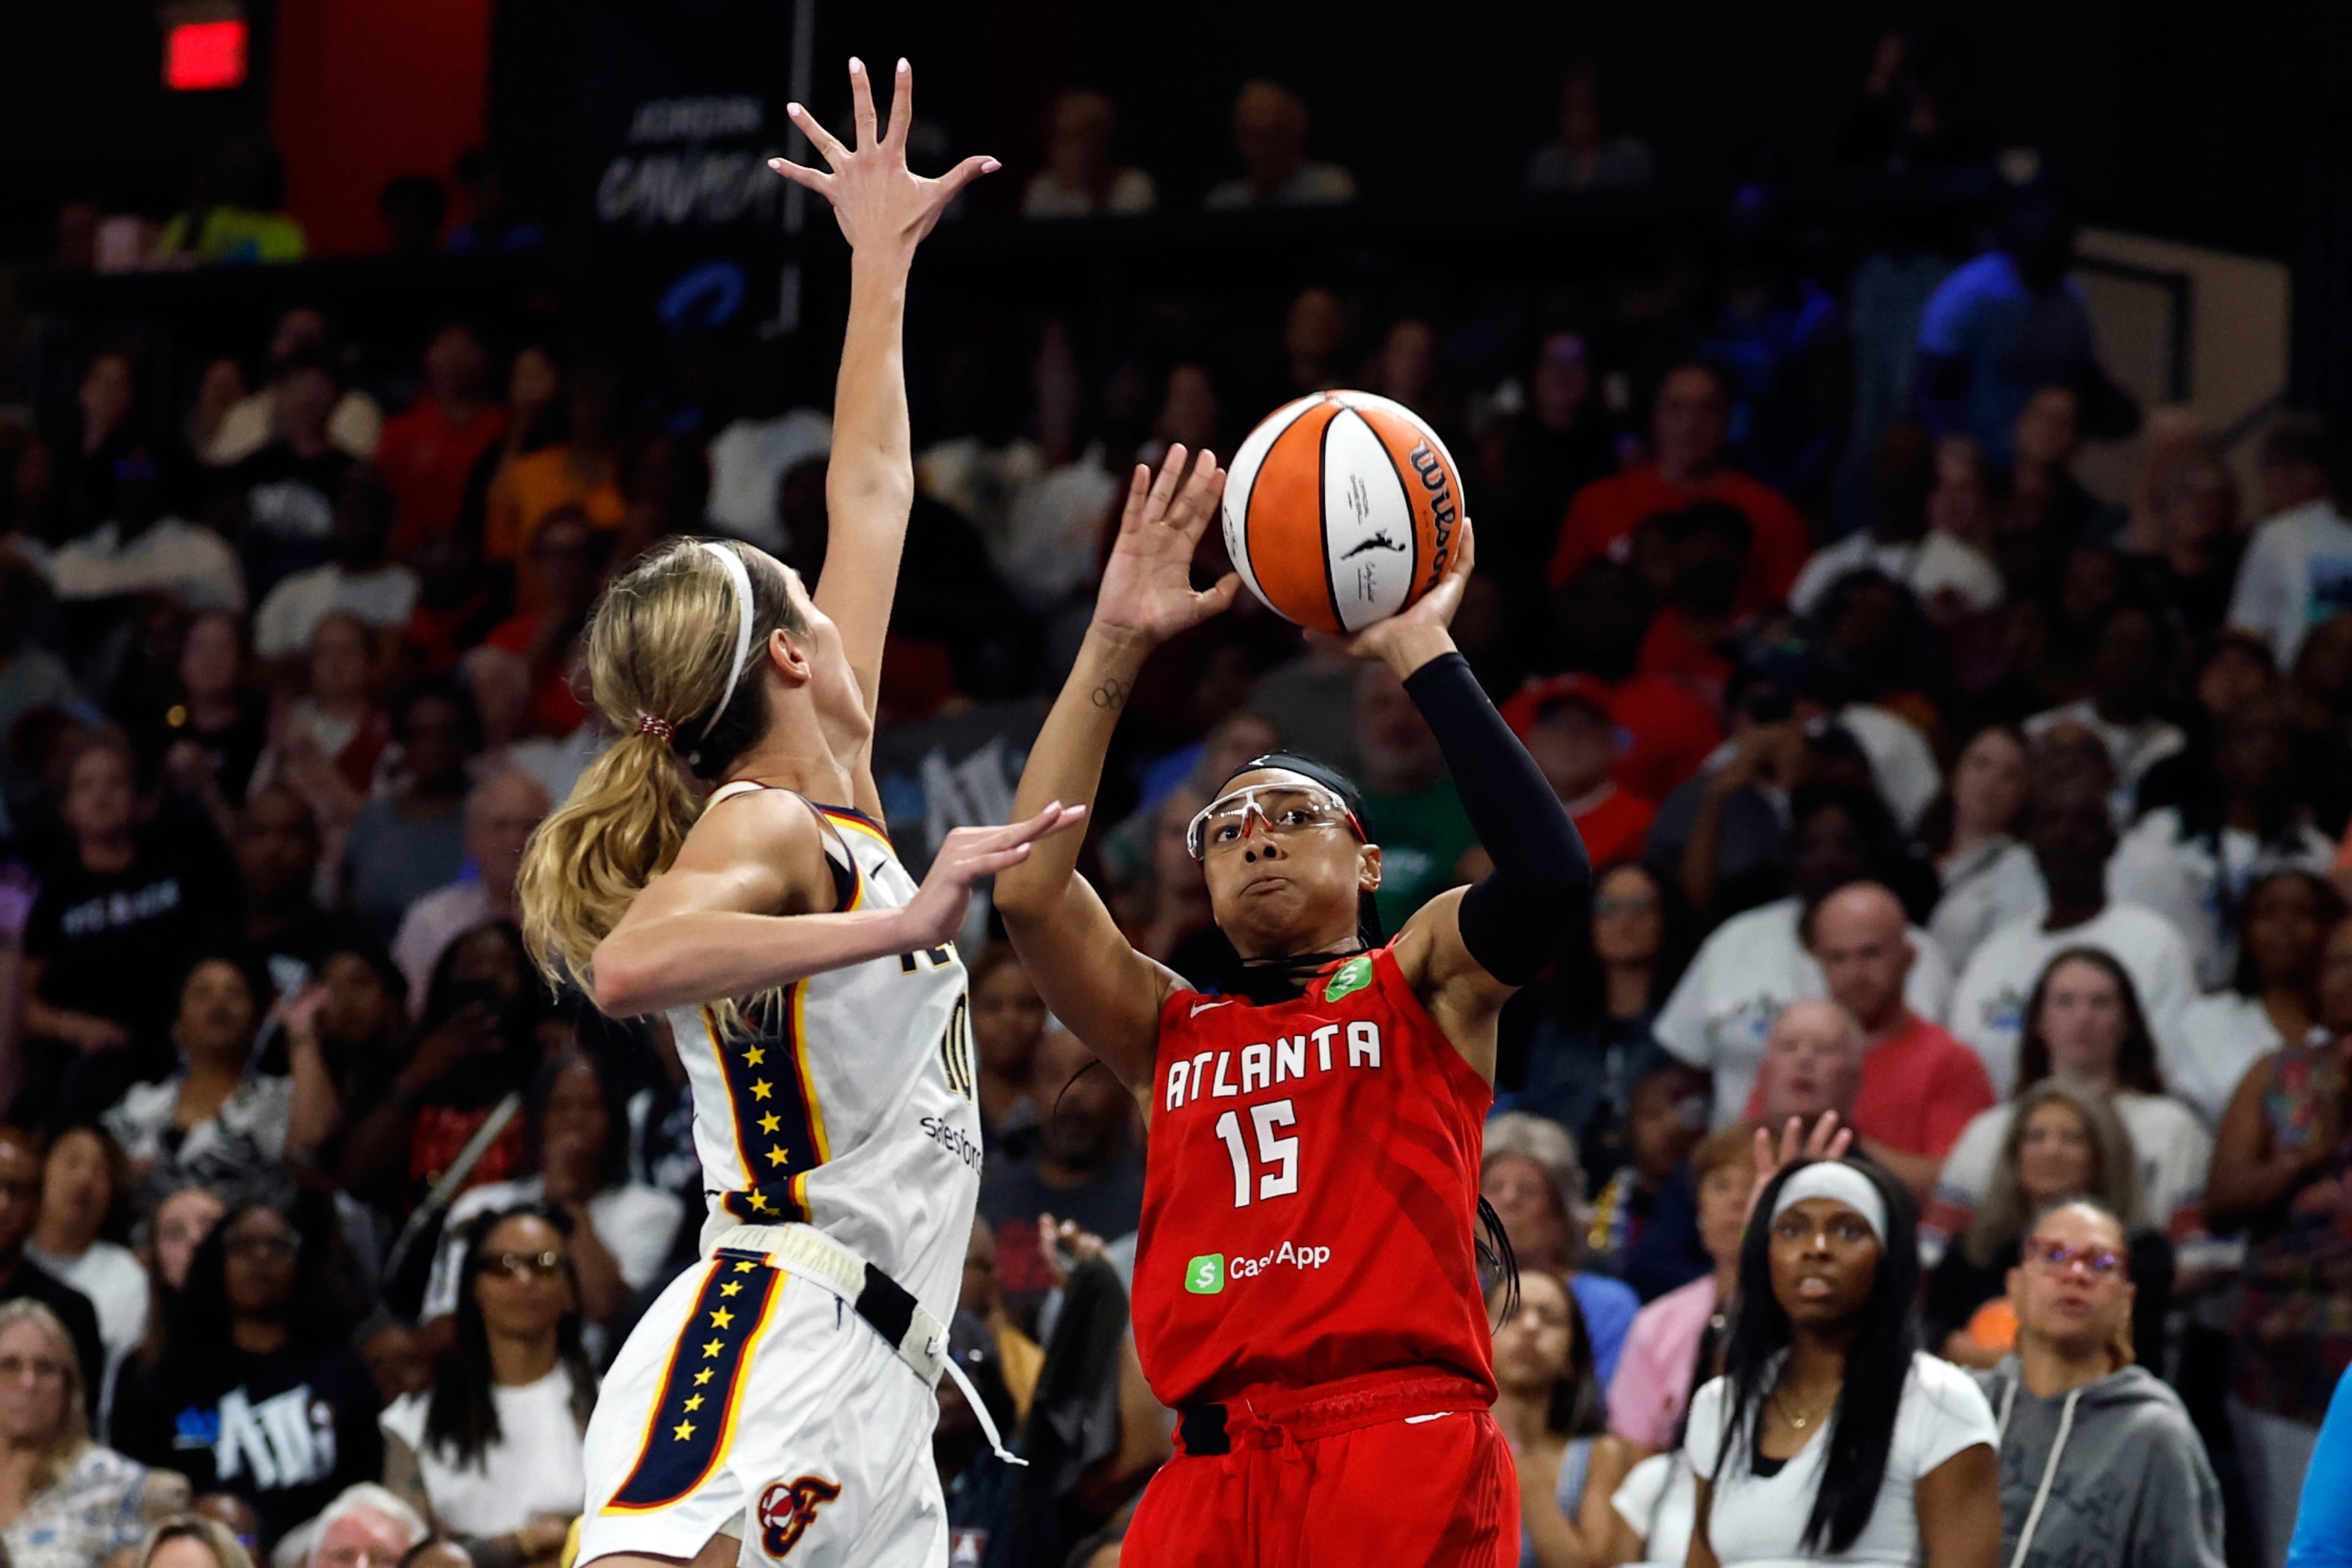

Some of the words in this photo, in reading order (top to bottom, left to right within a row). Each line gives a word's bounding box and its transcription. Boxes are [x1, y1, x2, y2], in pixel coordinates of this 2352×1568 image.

[1166, 1020, 1381, 1112] ATLANTA
[920, 1117, 982, 1175] salesforc
[1215, 1098, 1298, 1208] 15
[1275, 1240, 1331, 1270] App
